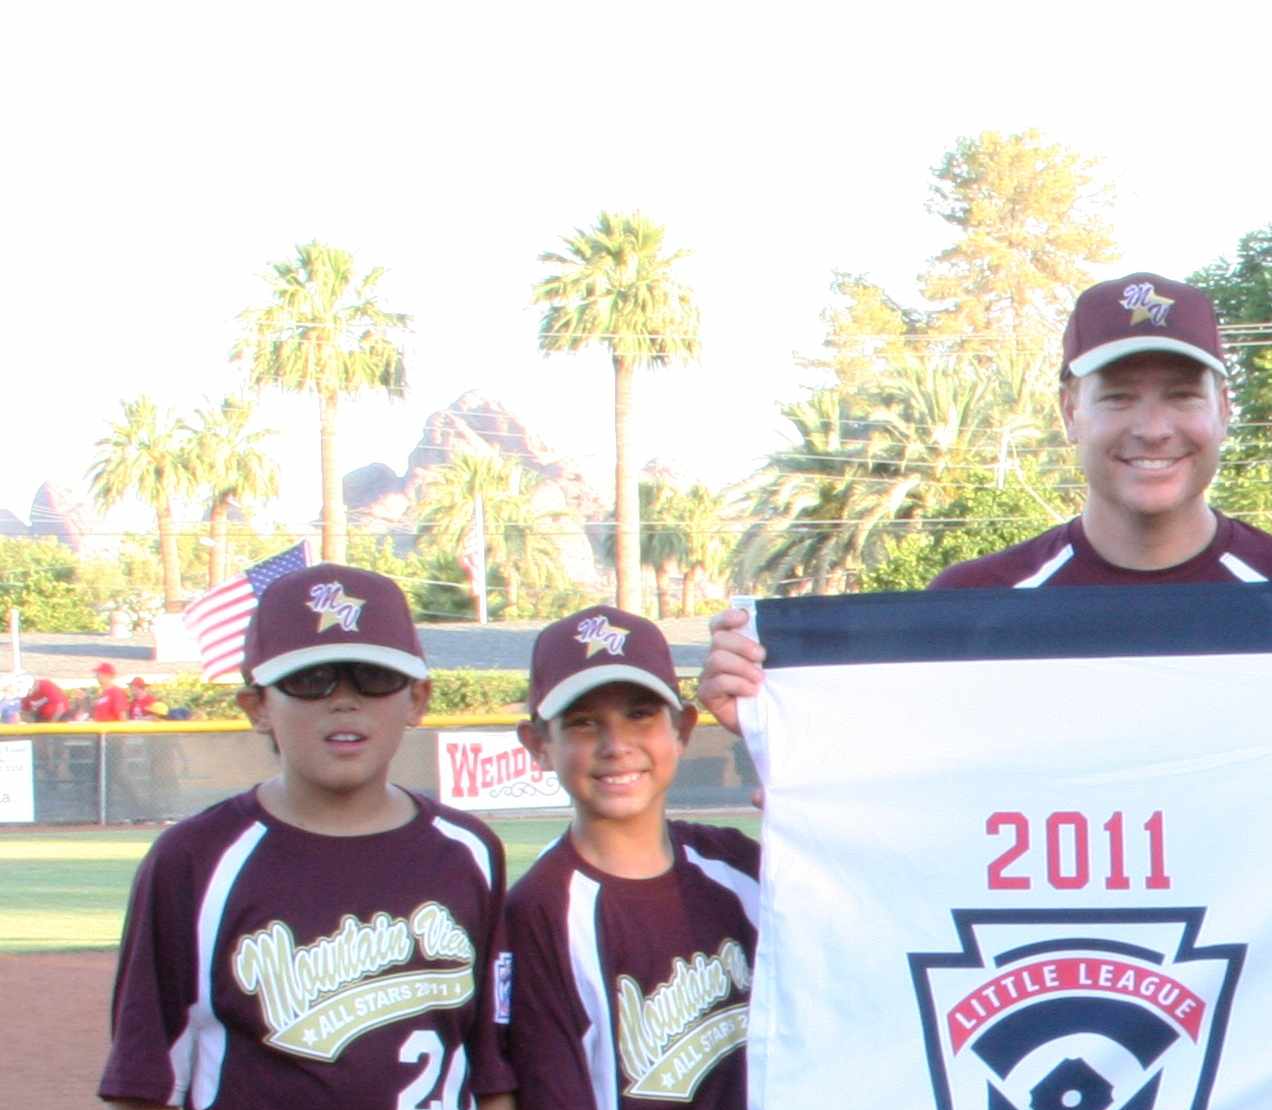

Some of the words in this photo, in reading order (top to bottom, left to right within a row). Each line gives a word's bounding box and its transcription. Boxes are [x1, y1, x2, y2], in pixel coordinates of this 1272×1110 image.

[986, 811, 1171, 889] 2011
[235, 914, 412, 1029] Mountain
[955, 965, 1059, 1029] LITTLE
[1079, 963, 1196, 1018] LEAGUE
[318, 1008, 356, 1039] ALL
[355, 984, 412, 1015] STARS
